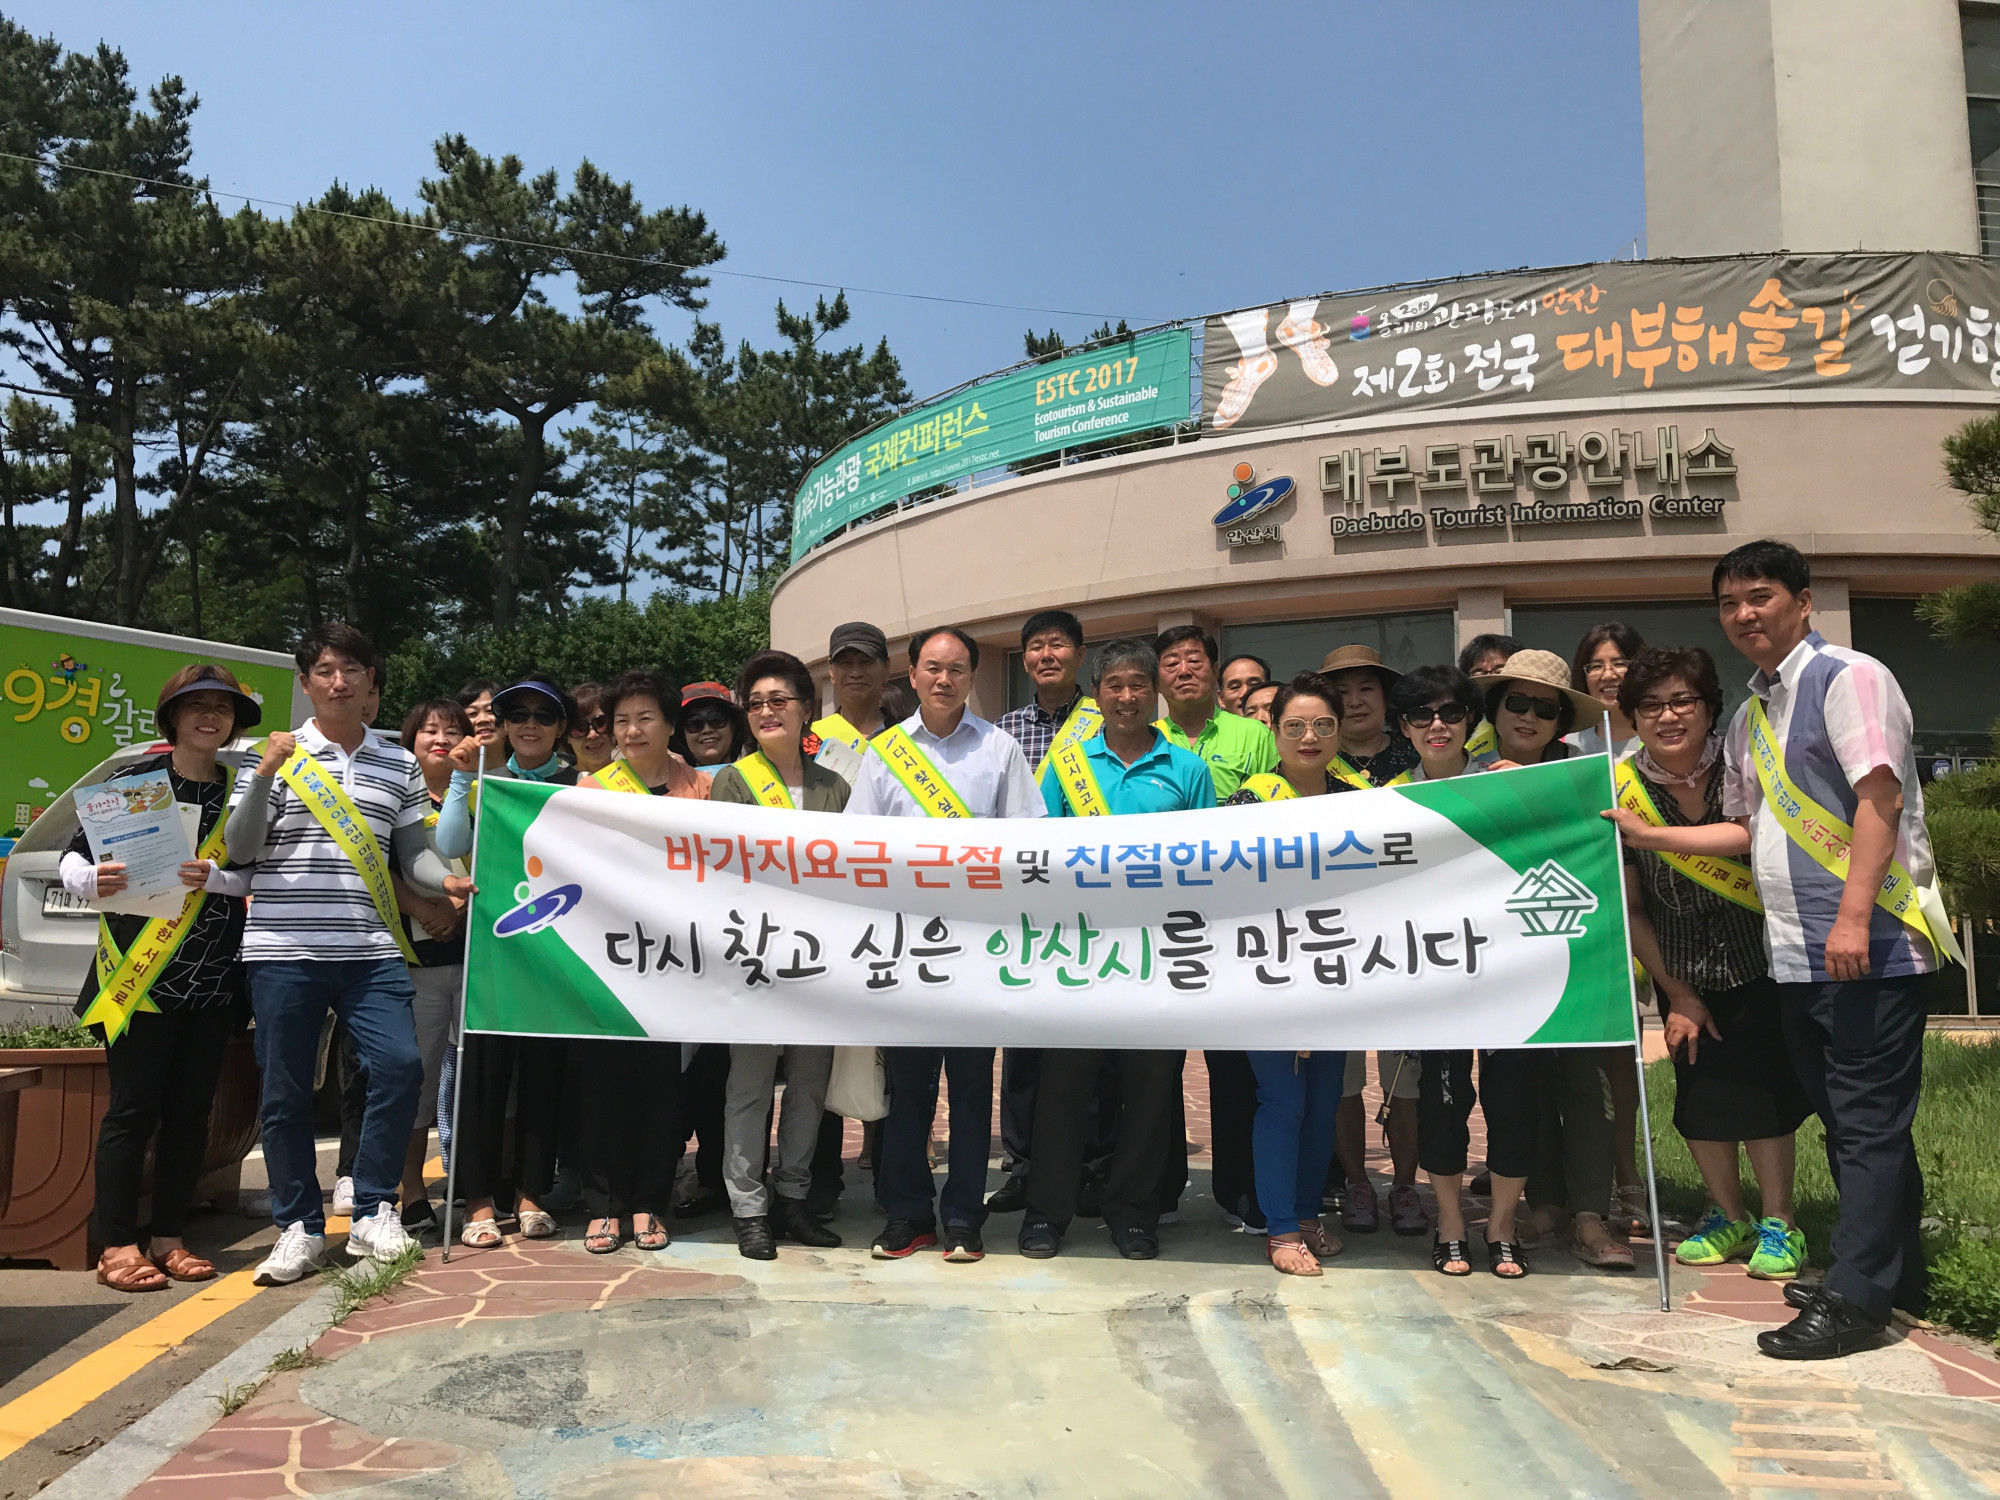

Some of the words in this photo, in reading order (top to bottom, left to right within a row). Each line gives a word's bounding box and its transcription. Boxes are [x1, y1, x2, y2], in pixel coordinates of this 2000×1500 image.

[1399, 301, 1431, 316] 2019
[1432, 298, 1537, 329] 관광도시
[1541, 283, 1608, 315] 안산
[1351, 346, 1456, 398] 제2회
[1463, 333, 1540, 393] 전국
[1556, 278, 1858, 388] 대부해솔길
[1034, 402, 1086, 426] Ecotourism
[1087, 398, 1096, 412] &
[1097, 385, 1159, 411] Sustainable
[1035, 369, 1081, 407] ESTC
[1084, 356, 1139, 392] 2017
[1034, 422, 1071, 443] Tourism
[1071, 411, 1130, 434] Conference
[801, 451, 862, 526] 지속가능관광
[864, 402, 990, 480] 국제컨퍼런스
[1318, 425, 1738, 504] 대부도관광안내소
[1226, 525, 1282, 546] 안산시
[1331, 510, 1425, 536] Daebudo
[1431, 504, 1505, 528] Tourist
[1512, 497, 1643, 523] Information
[1650, 494, 1725, 516] Center
[892, 744, 919, 771] 다시
[914, 769, 941, 799] 찾고
[1062, 753, 1082, 777] 다시
[1074, 778, 1095, 807] 찾고
[330, 805, 366, 846] 이용하면
[663, 833, 893, 890] 바가지요금
[906, 844, 1003, 890] 근절
[1016, 848, 1050, 885] 및
[1064, 830, 1419, 889] 친절한서비스로
[1733, 877, 1752, 891] 및
[605, 920, 702, 976] 다시
[722, 909, 829, 987] 찾고
[851, 912, 963, 990] 싶은
[984, 909, 1214, 991] 안산시를
[1236, 907, 1489, 987] 만듭시다
[111, 947, 160, 1007] 서비스로
